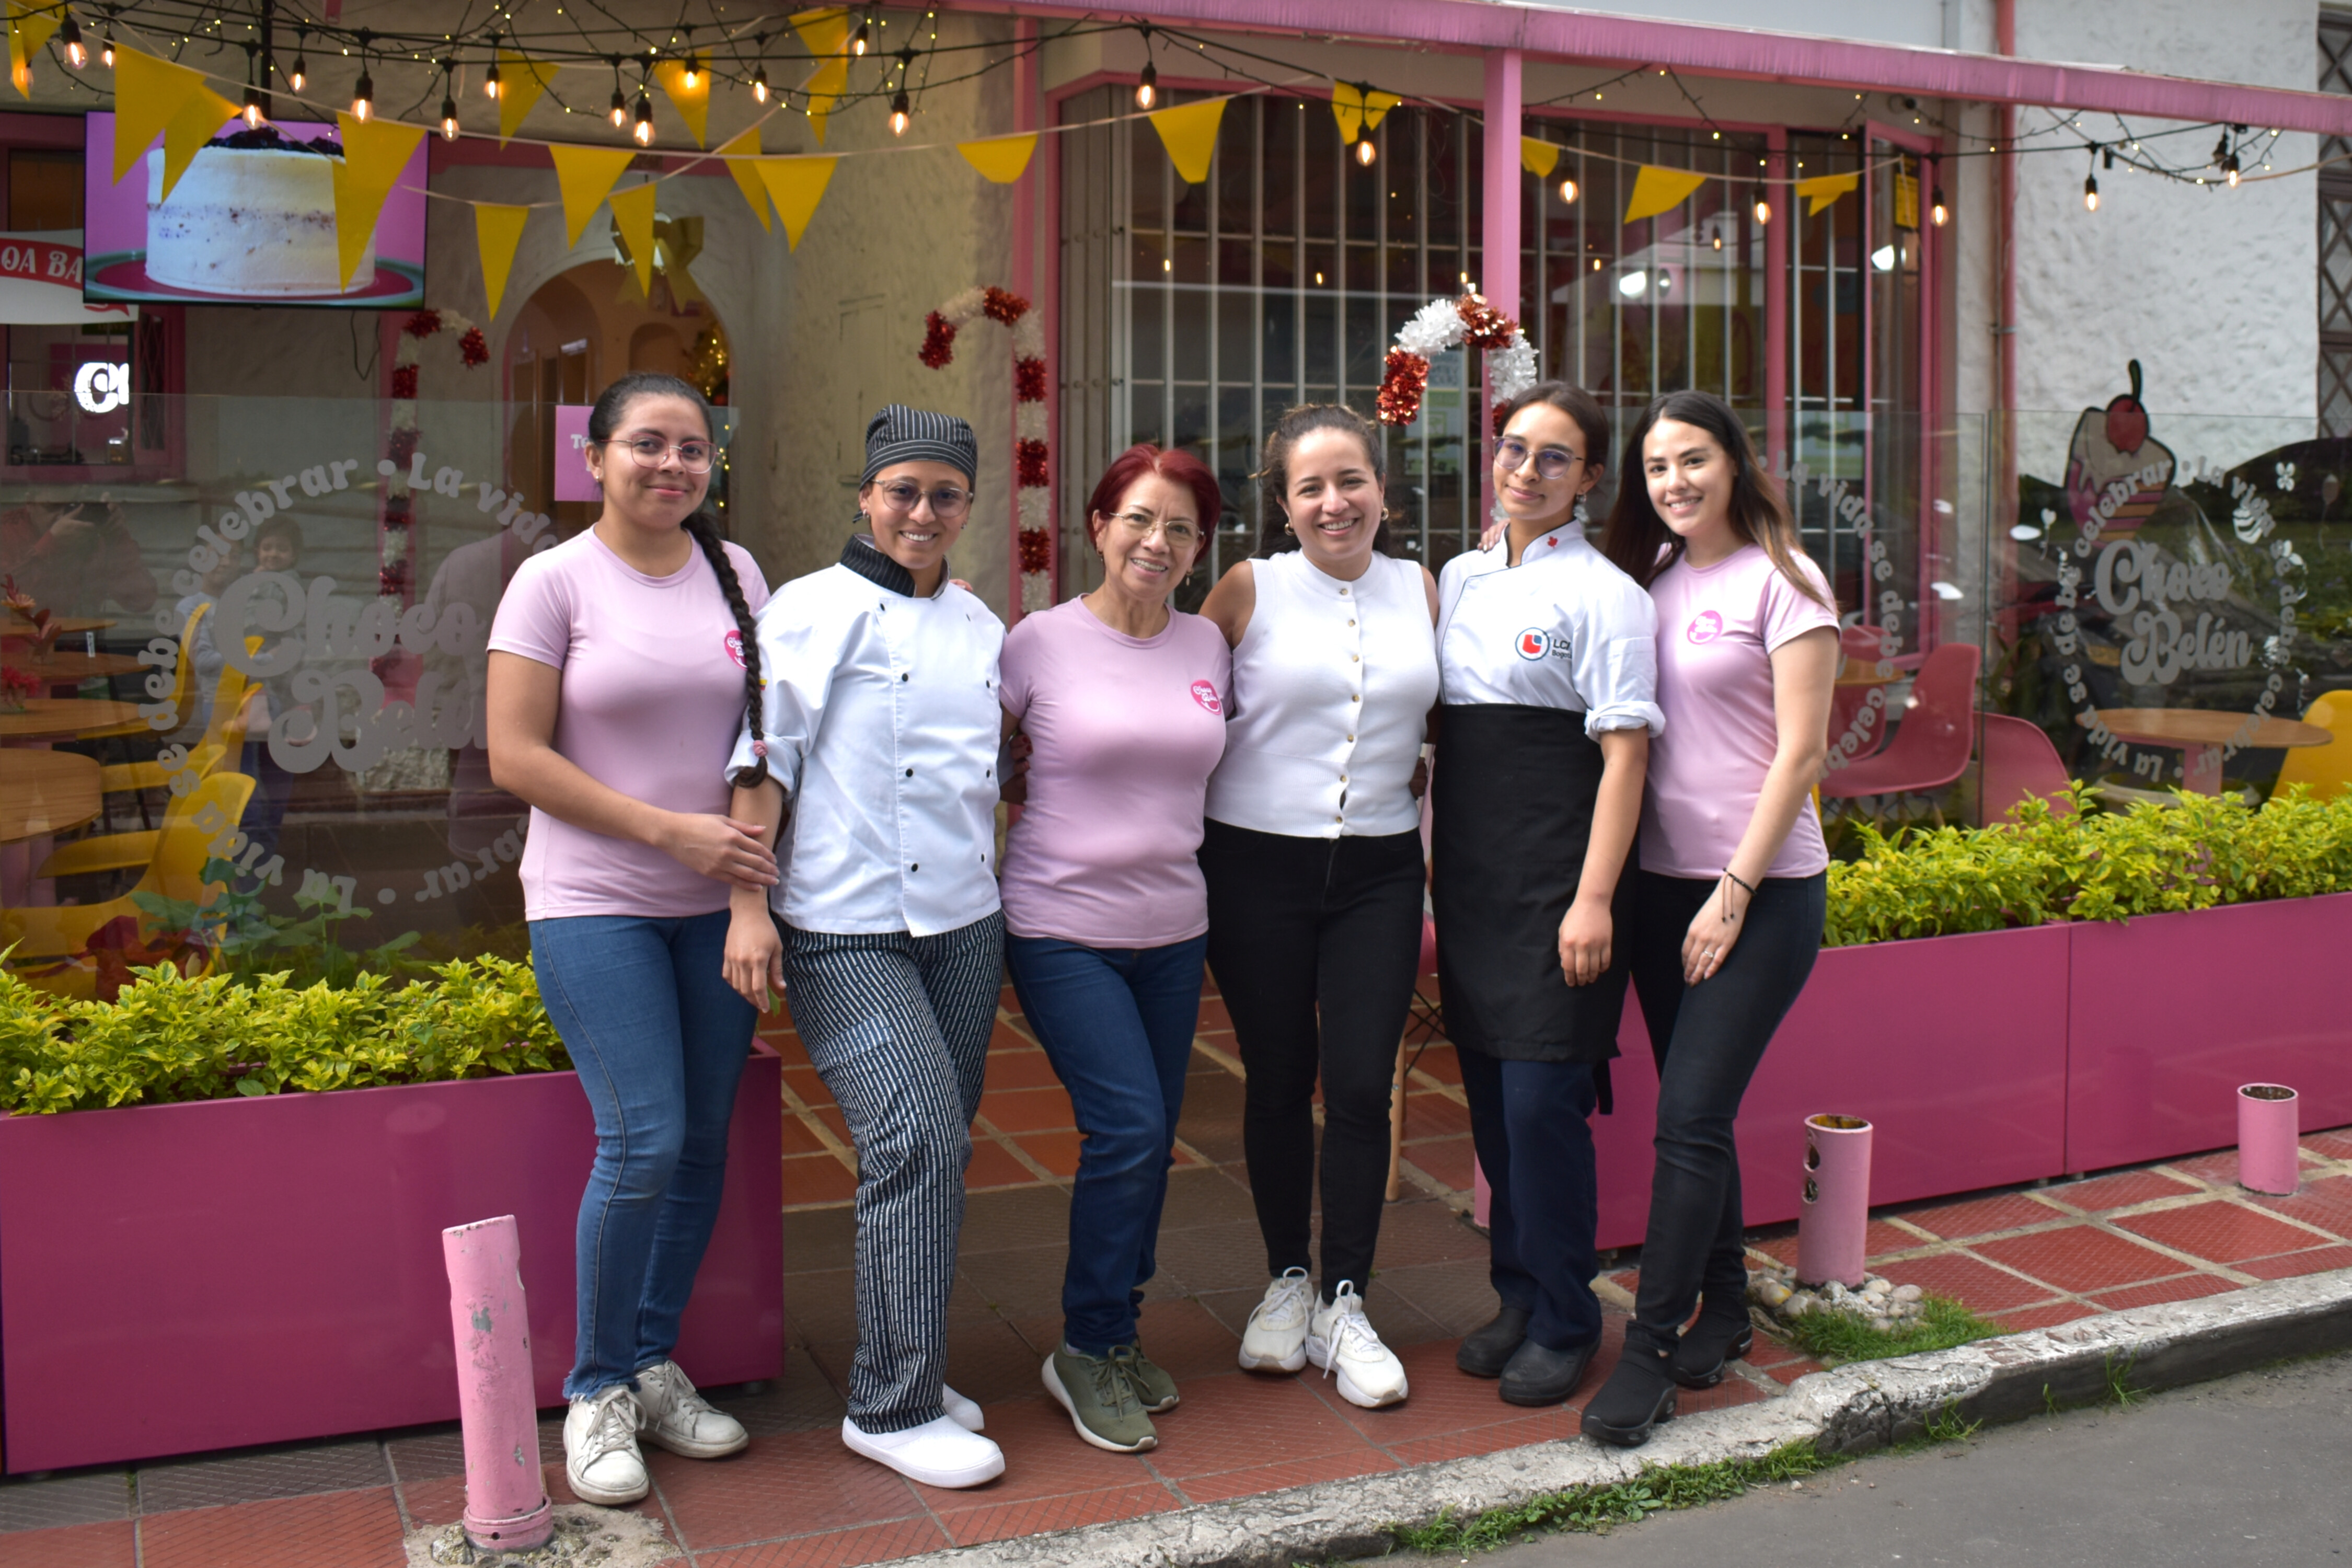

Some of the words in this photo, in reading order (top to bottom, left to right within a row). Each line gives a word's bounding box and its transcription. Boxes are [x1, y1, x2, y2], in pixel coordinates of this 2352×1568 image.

[407, 452, 464, 498] La
[1775, 449, 1810, 486] La
[2197, 455, 2226, 489] La
[172, 458, 359, 597] celebrar
[1817, 472, 1874, 539] vida
[2074, 458, 2173, 558] celebrar
[1868, 540, 1894, 582] se
[2094, 539, 2235, 615] Choco
[214, 571, 487, 677] Choco
[1875, 590, 1904, 679] debe
[2120, 610, 2254, 686] Belén
[137, 609, 186, 731] debe
[2063, 663, 2088, 704] se
[2080, 704, 2129, 766] vida
[157, 743, 201, 799] se
[2134, 752, 2164, 783] La
[191, 800, 285, 886] vida
[298, 868, 357, 914] La
